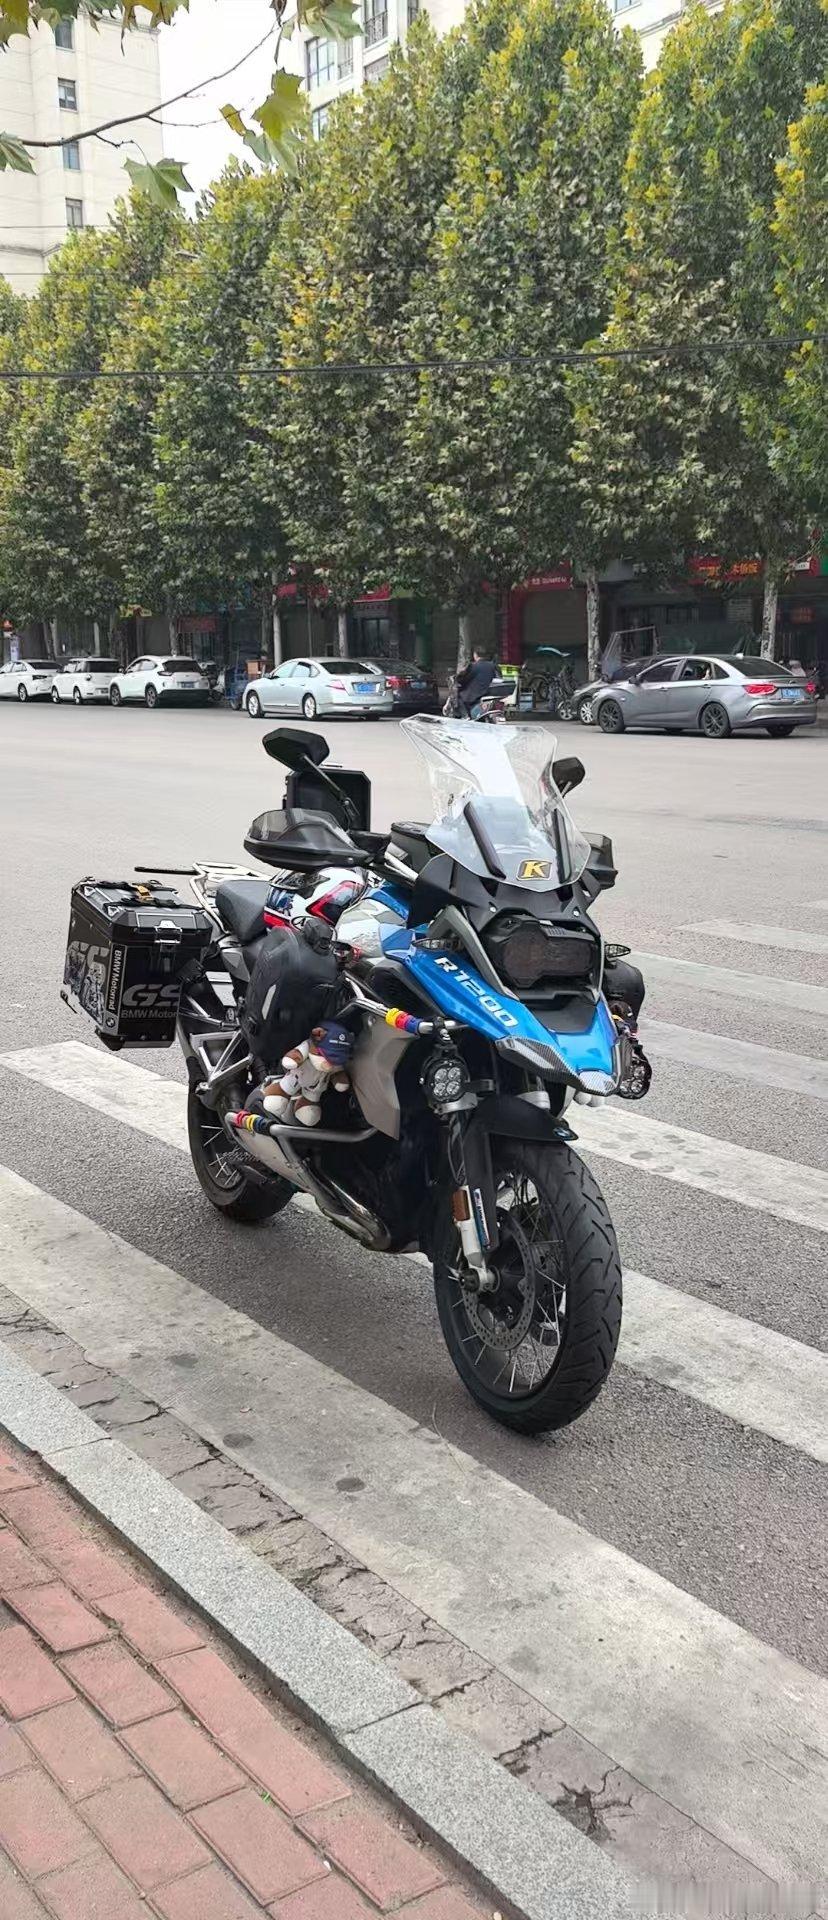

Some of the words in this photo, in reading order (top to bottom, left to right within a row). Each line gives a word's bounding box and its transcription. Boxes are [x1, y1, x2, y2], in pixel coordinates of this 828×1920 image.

[521, 861, 548, 878] K
[113, 950, 122, 973] BMW
[108, 973, 120, 1010] Motorrad
[122, 984, 182, 1006] GS
[121, 1009, 148, 1018] BMW
